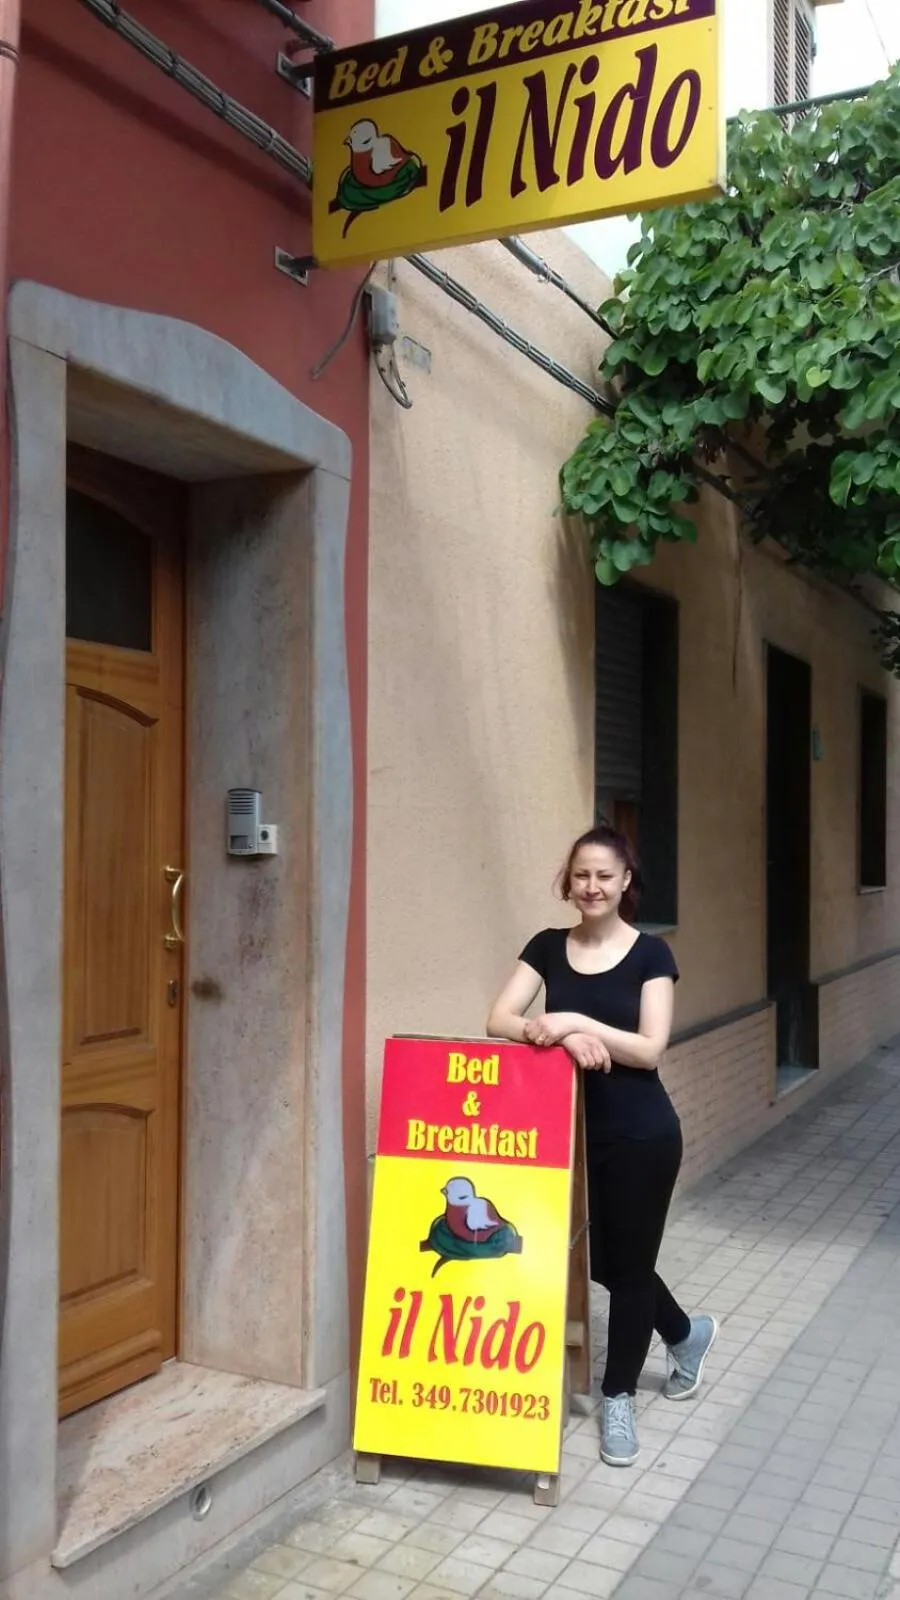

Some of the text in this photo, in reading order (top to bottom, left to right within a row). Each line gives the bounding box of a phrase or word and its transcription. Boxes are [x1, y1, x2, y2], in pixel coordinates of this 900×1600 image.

[328, 45, 409, 100] Bed
[418, 36, 454, 77] &
[438, 43, 702, 212] il Nido
[446, 1052, 500, 1086] Bed
[462, 1091, 481, 1117] &
[406, 1119, 539, 1159] Breakfast
[381, 1287, 546, 1374] il Nido
[369, 1377, 551, 1421] Tel. 349.7301923
